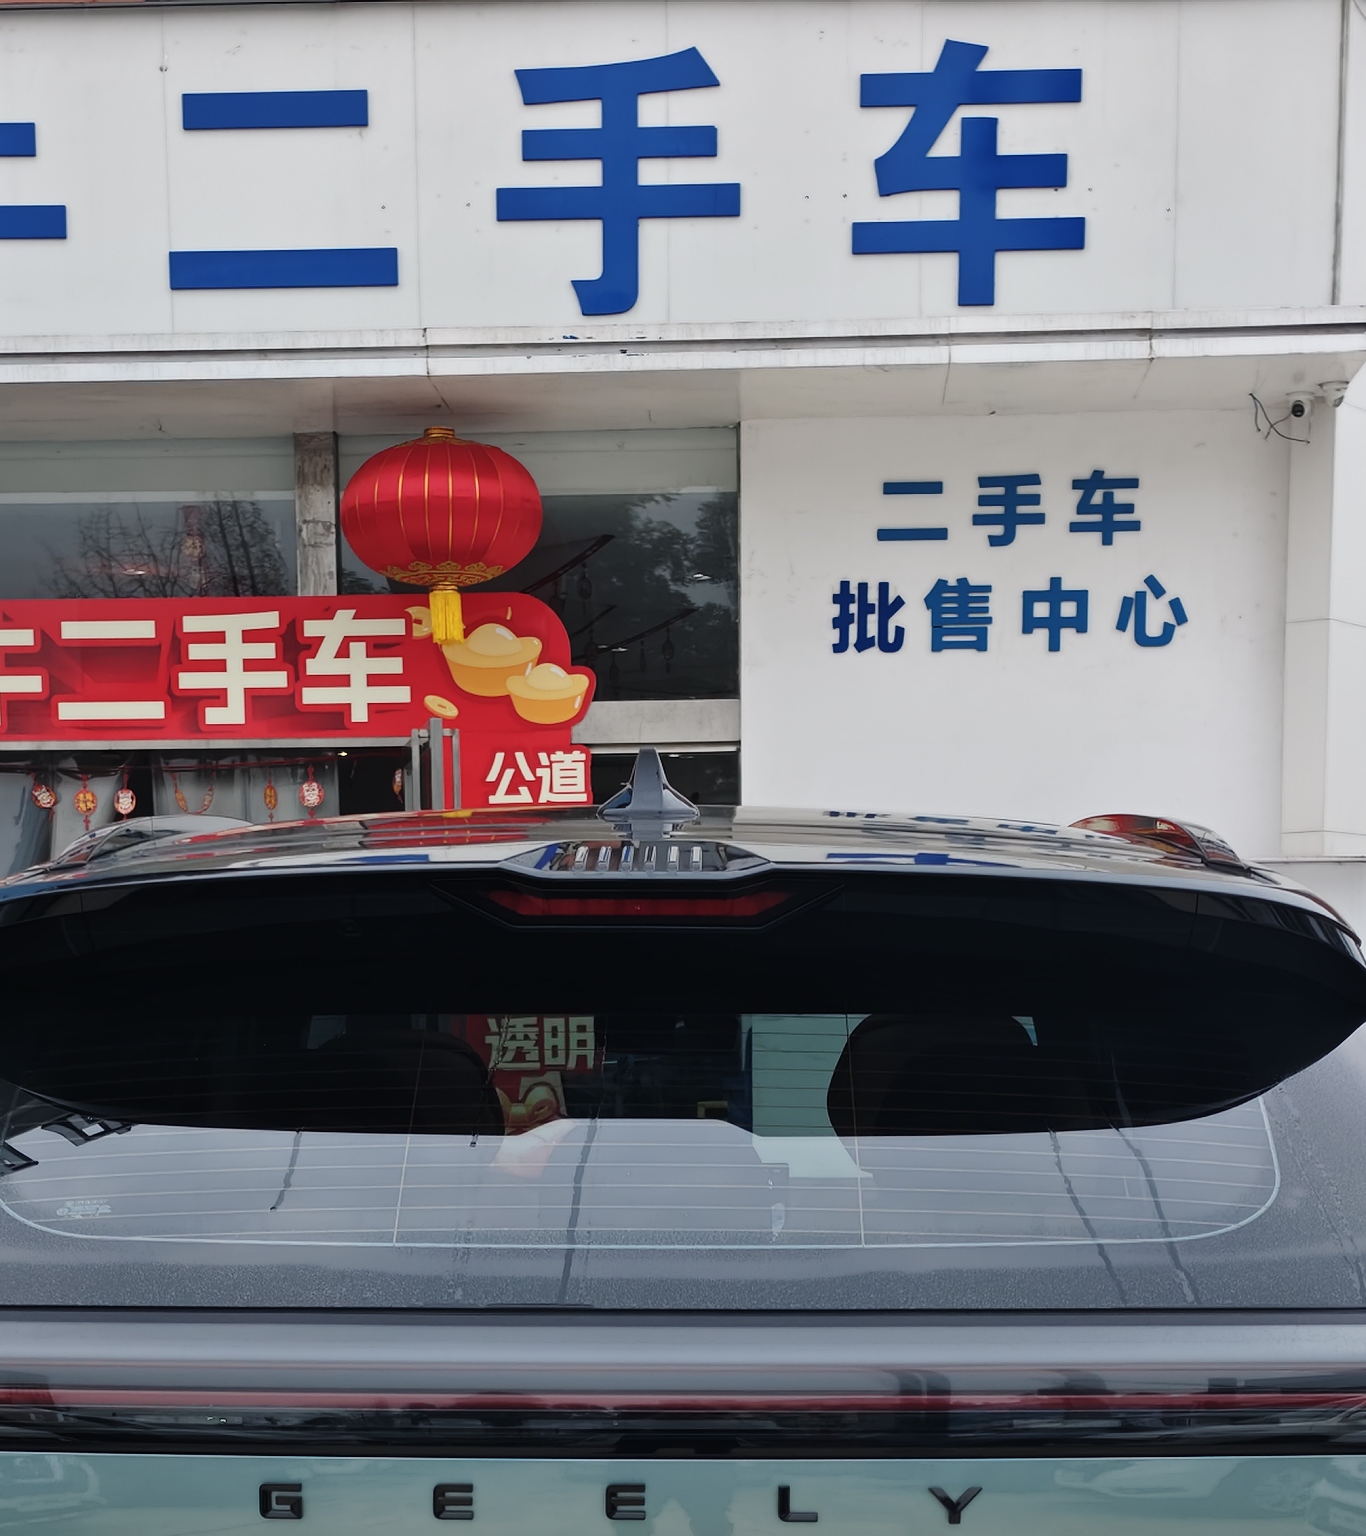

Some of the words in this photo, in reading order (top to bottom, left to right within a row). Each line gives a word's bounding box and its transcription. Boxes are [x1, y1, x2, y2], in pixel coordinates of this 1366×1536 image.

[876, 470, 1142, 547] 二手车
[831, 573, 1189, 656] 批售中心
[485, 750, 588, 804] 公道
[485, 1016, 595, 1070] 透明
[258, 1482, 983, 1526] GEELY
